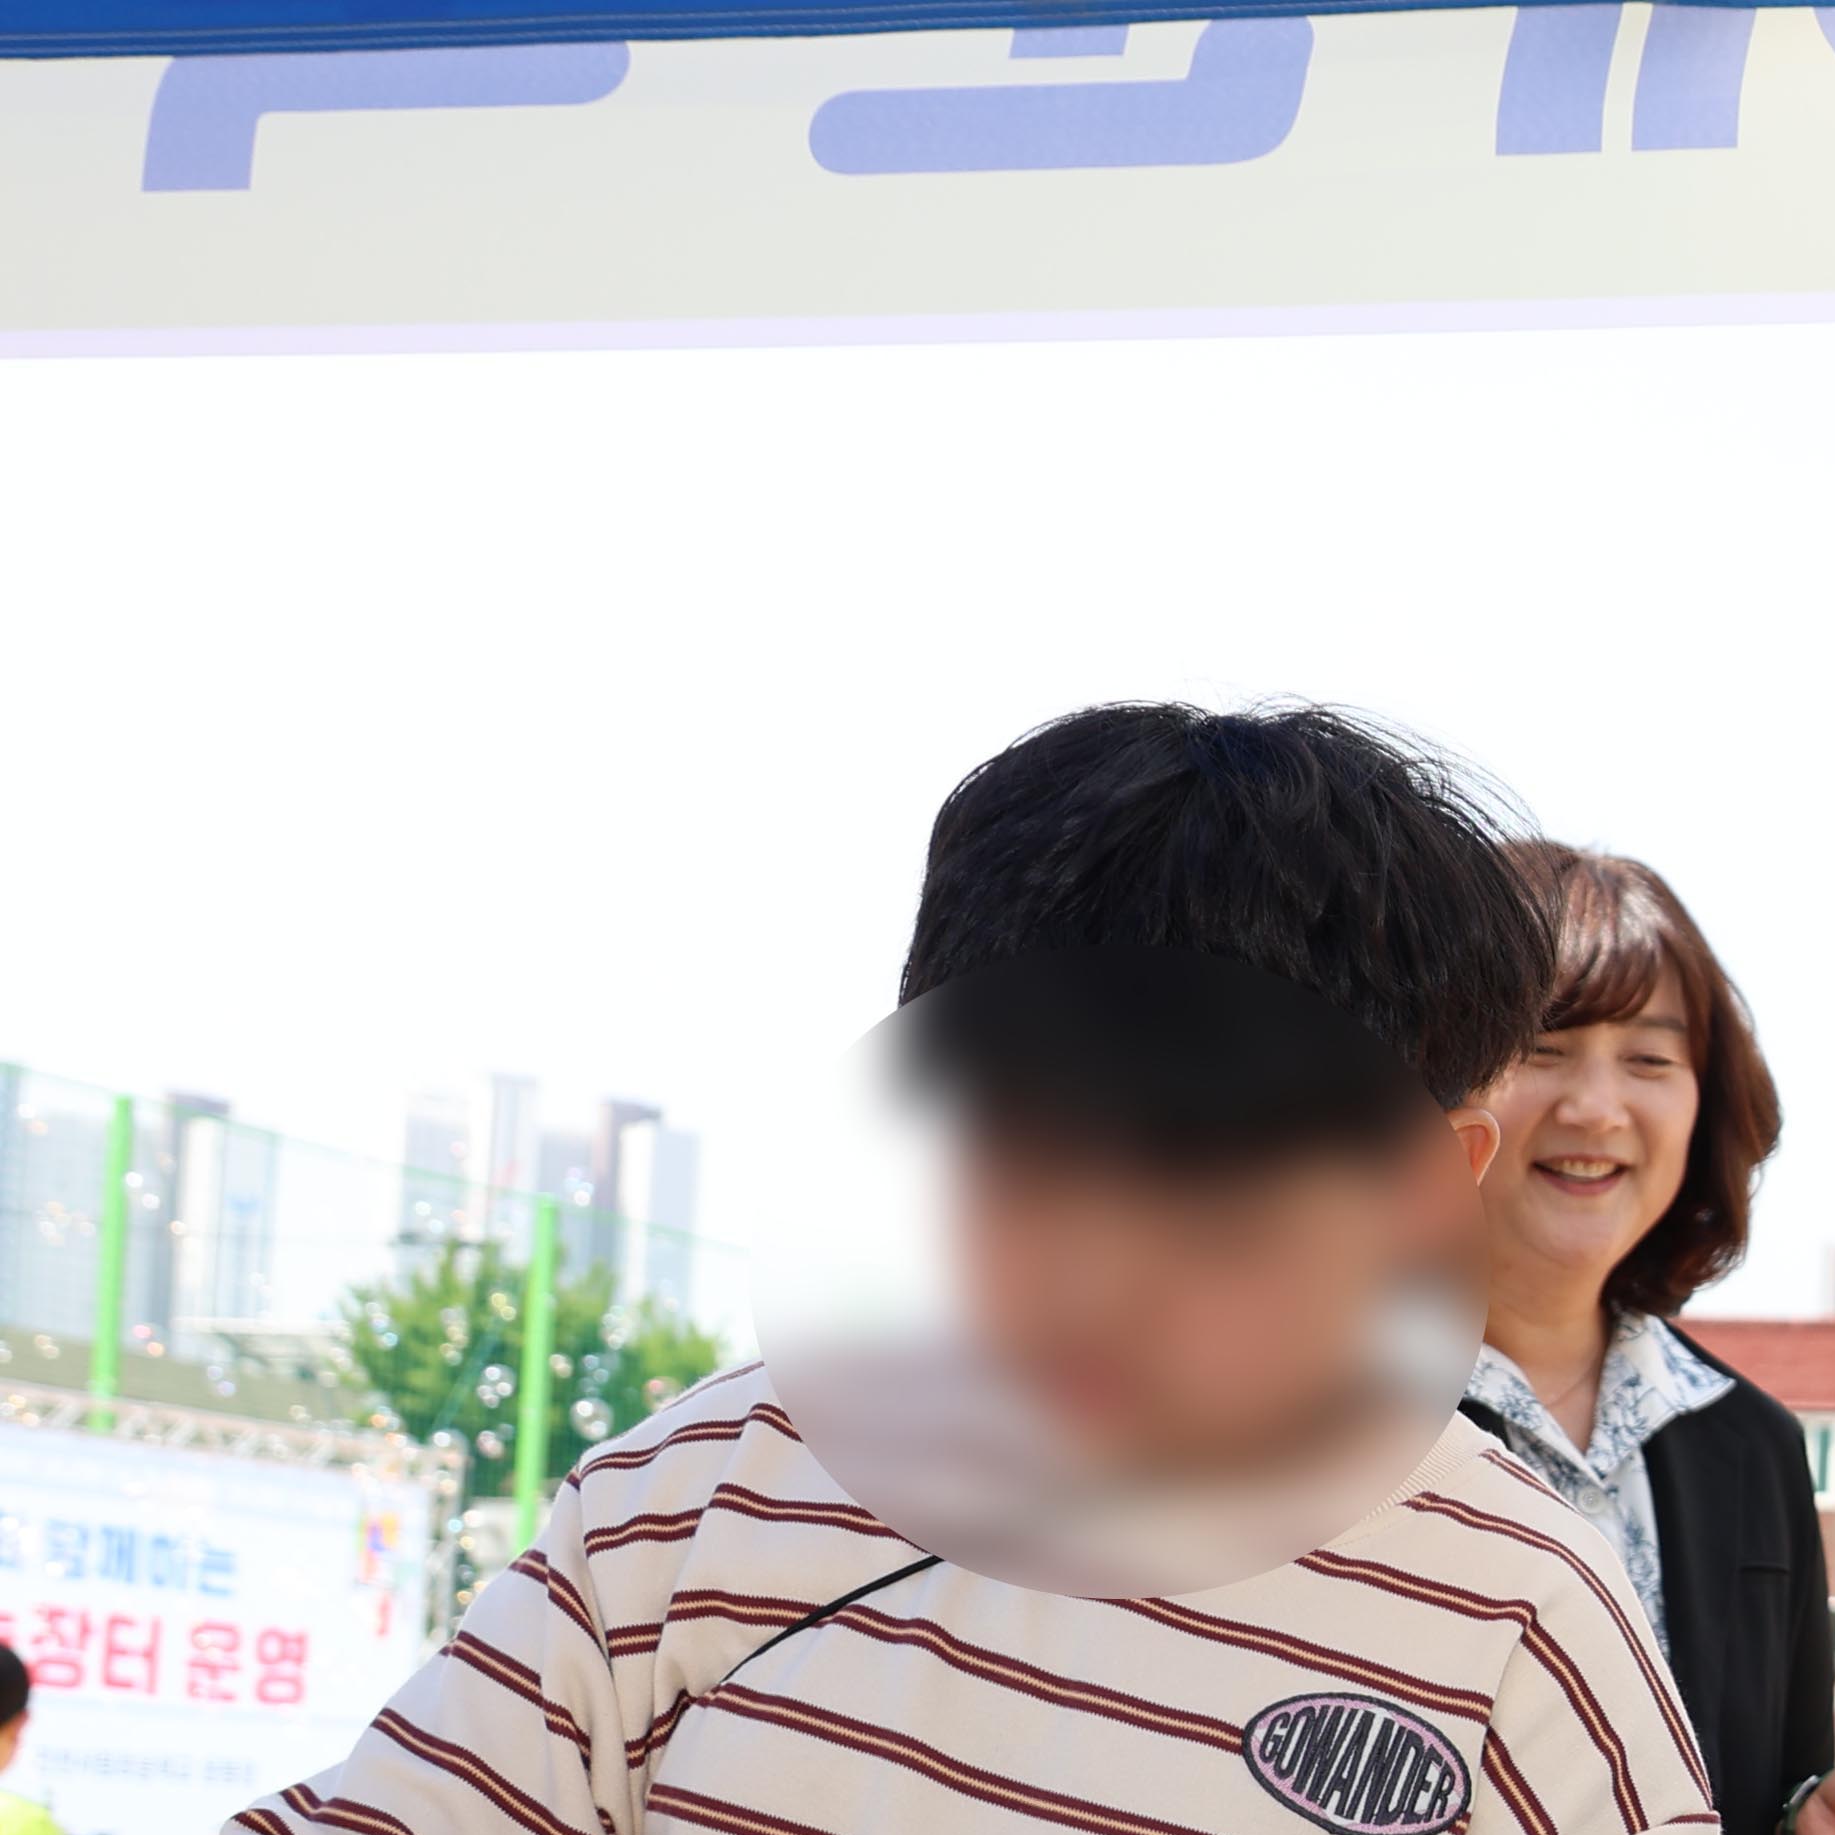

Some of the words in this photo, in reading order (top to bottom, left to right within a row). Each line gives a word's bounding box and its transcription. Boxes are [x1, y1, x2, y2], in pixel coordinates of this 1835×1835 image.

[0, 1602, 161, 1697] 장터
[185, 1617, 310, 1706] 운영
[1259, 1703, 1456, 1826] GOWANDER
